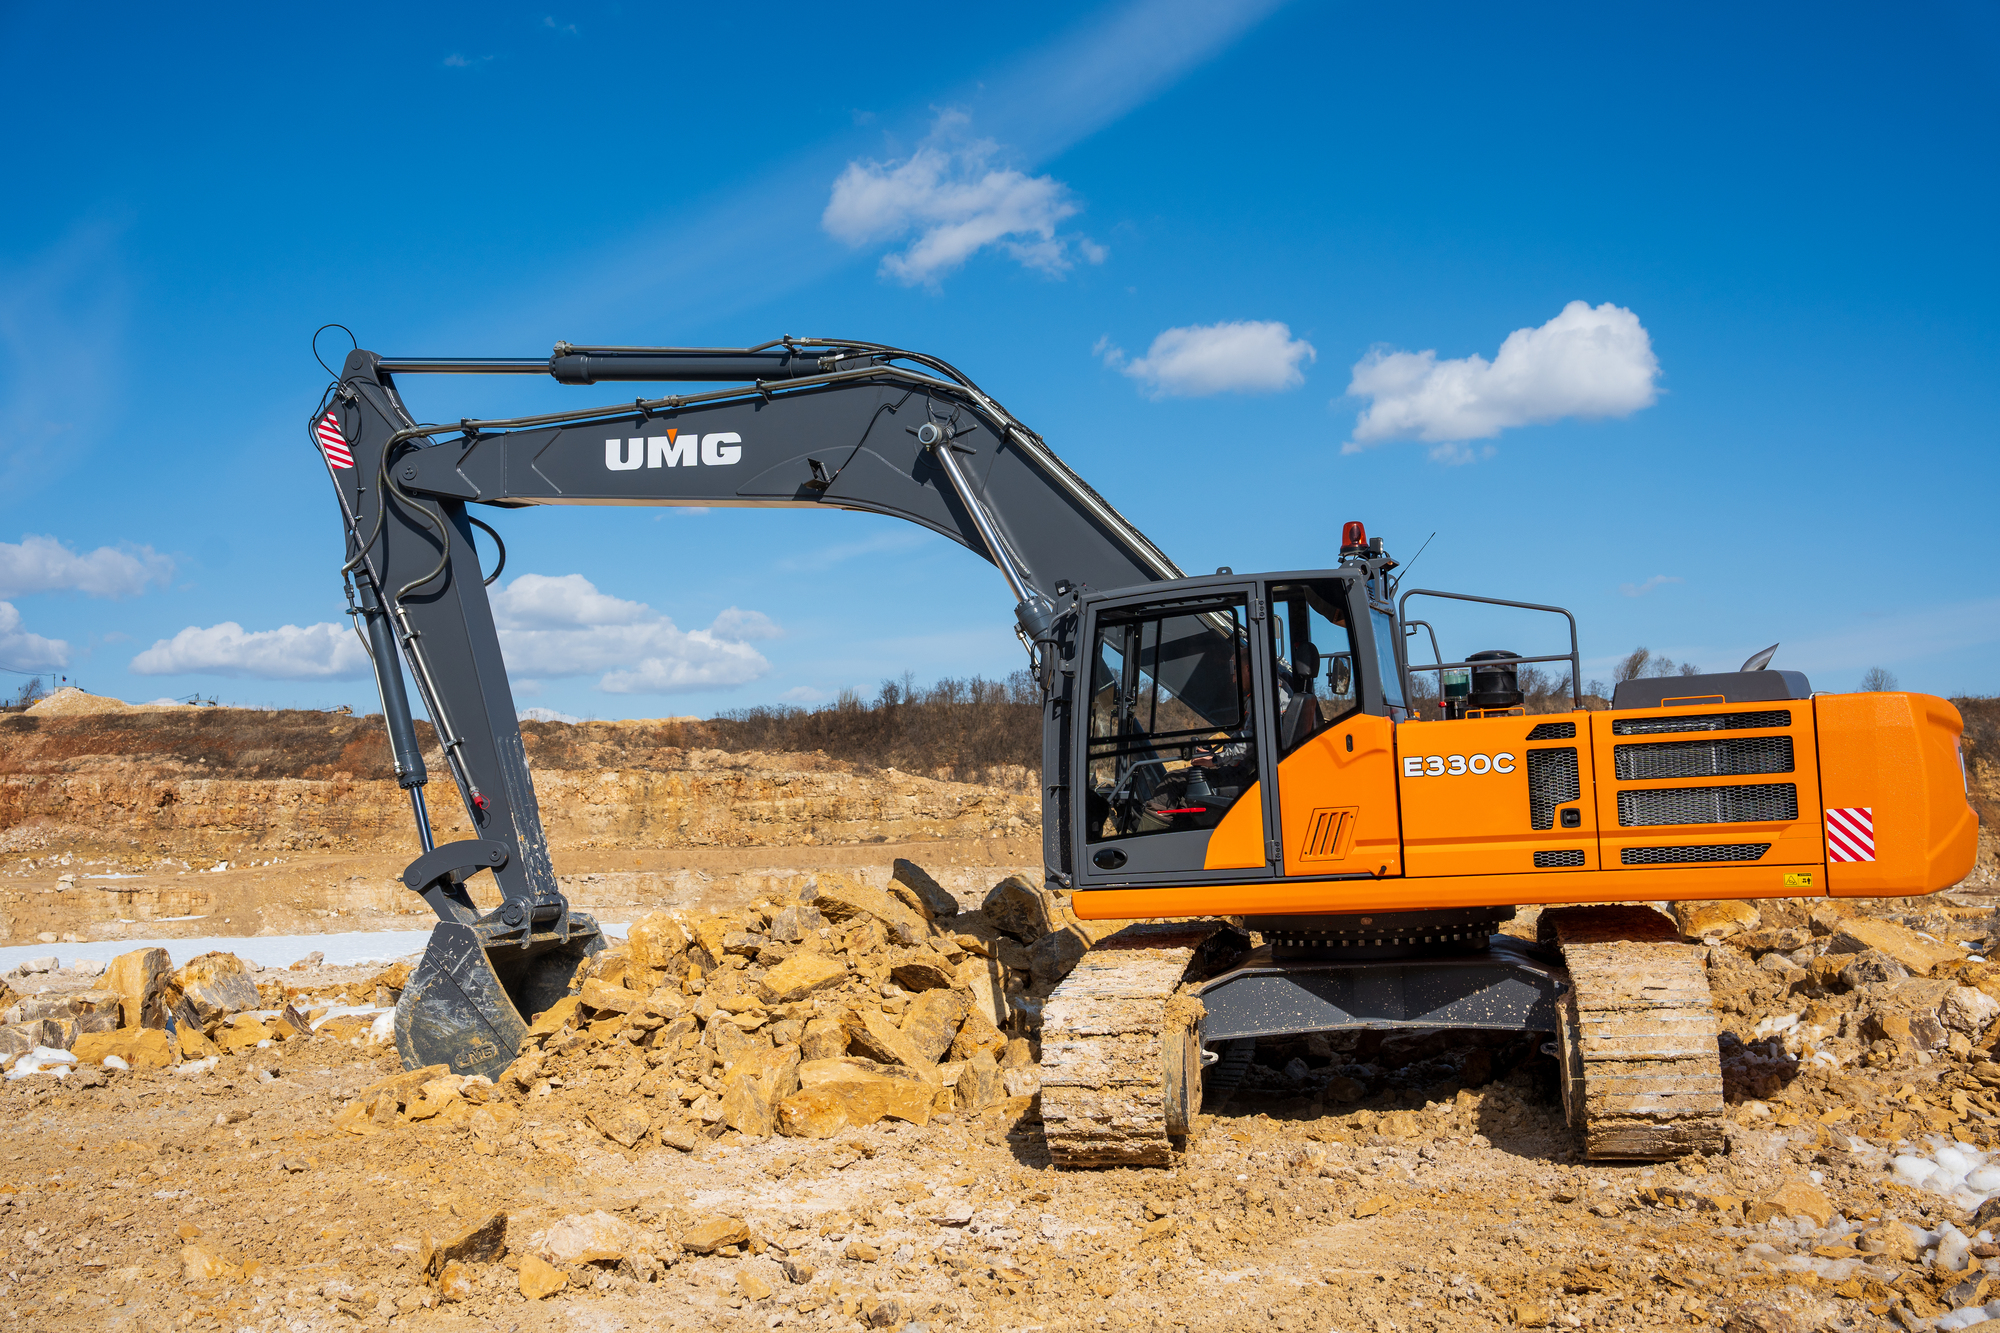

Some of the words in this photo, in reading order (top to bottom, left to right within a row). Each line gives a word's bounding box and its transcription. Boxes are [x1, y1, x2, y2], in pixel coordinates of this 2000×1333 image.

[605, 431, 742, 471] UMG
[1403, 752, 1516, 777] E330C
[458, 1044, 493, 1067] UMG
